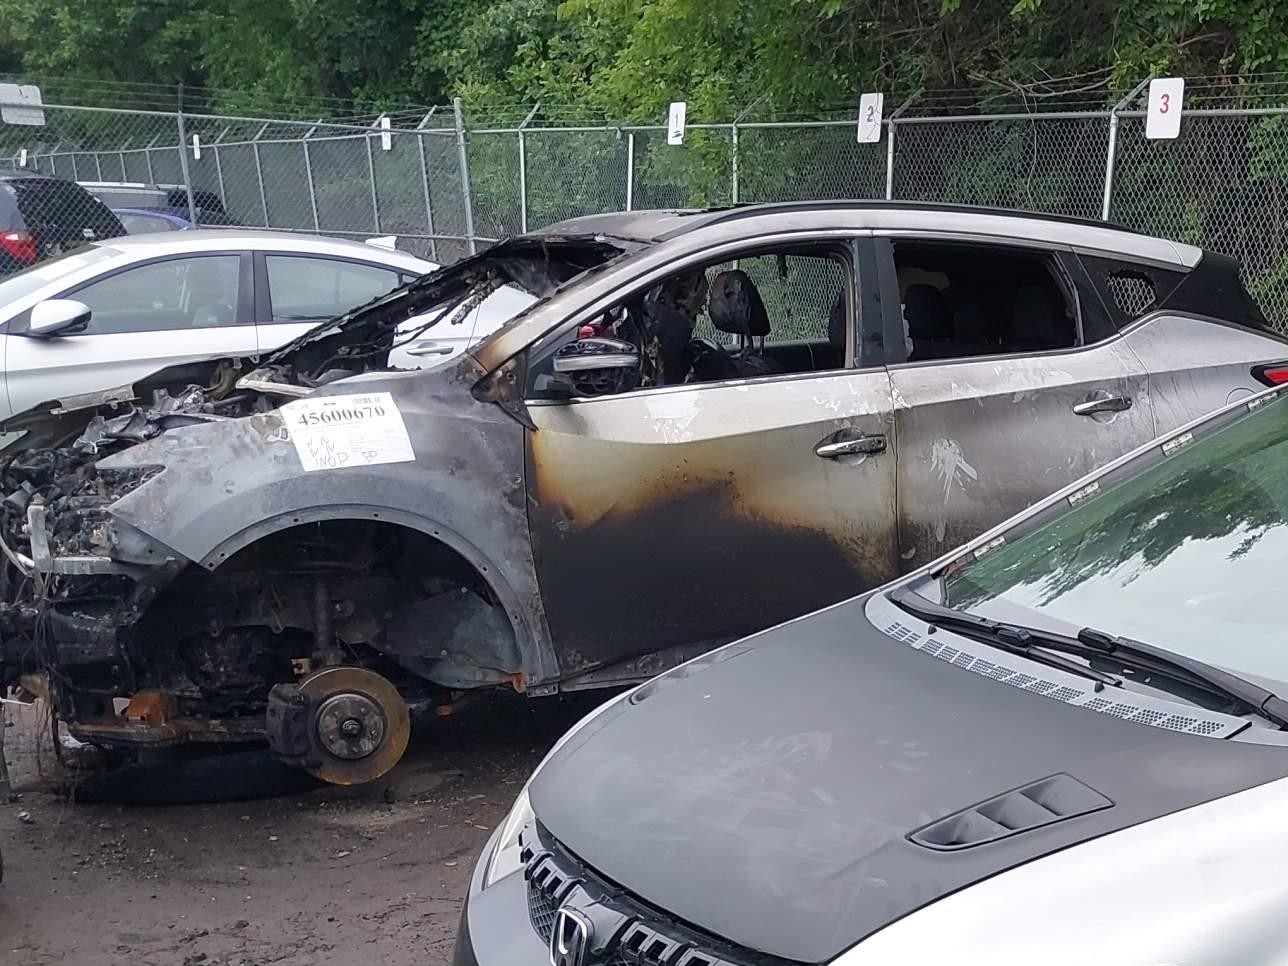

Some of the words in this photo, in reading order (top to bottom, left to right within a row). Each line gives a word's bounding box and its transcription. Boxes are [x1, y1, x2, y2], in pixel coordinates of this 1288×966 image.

[866, 105, 874, 122] 2
[1160, 93, 1170, 114] 3
[298, 405, 385, 426] 45600670
